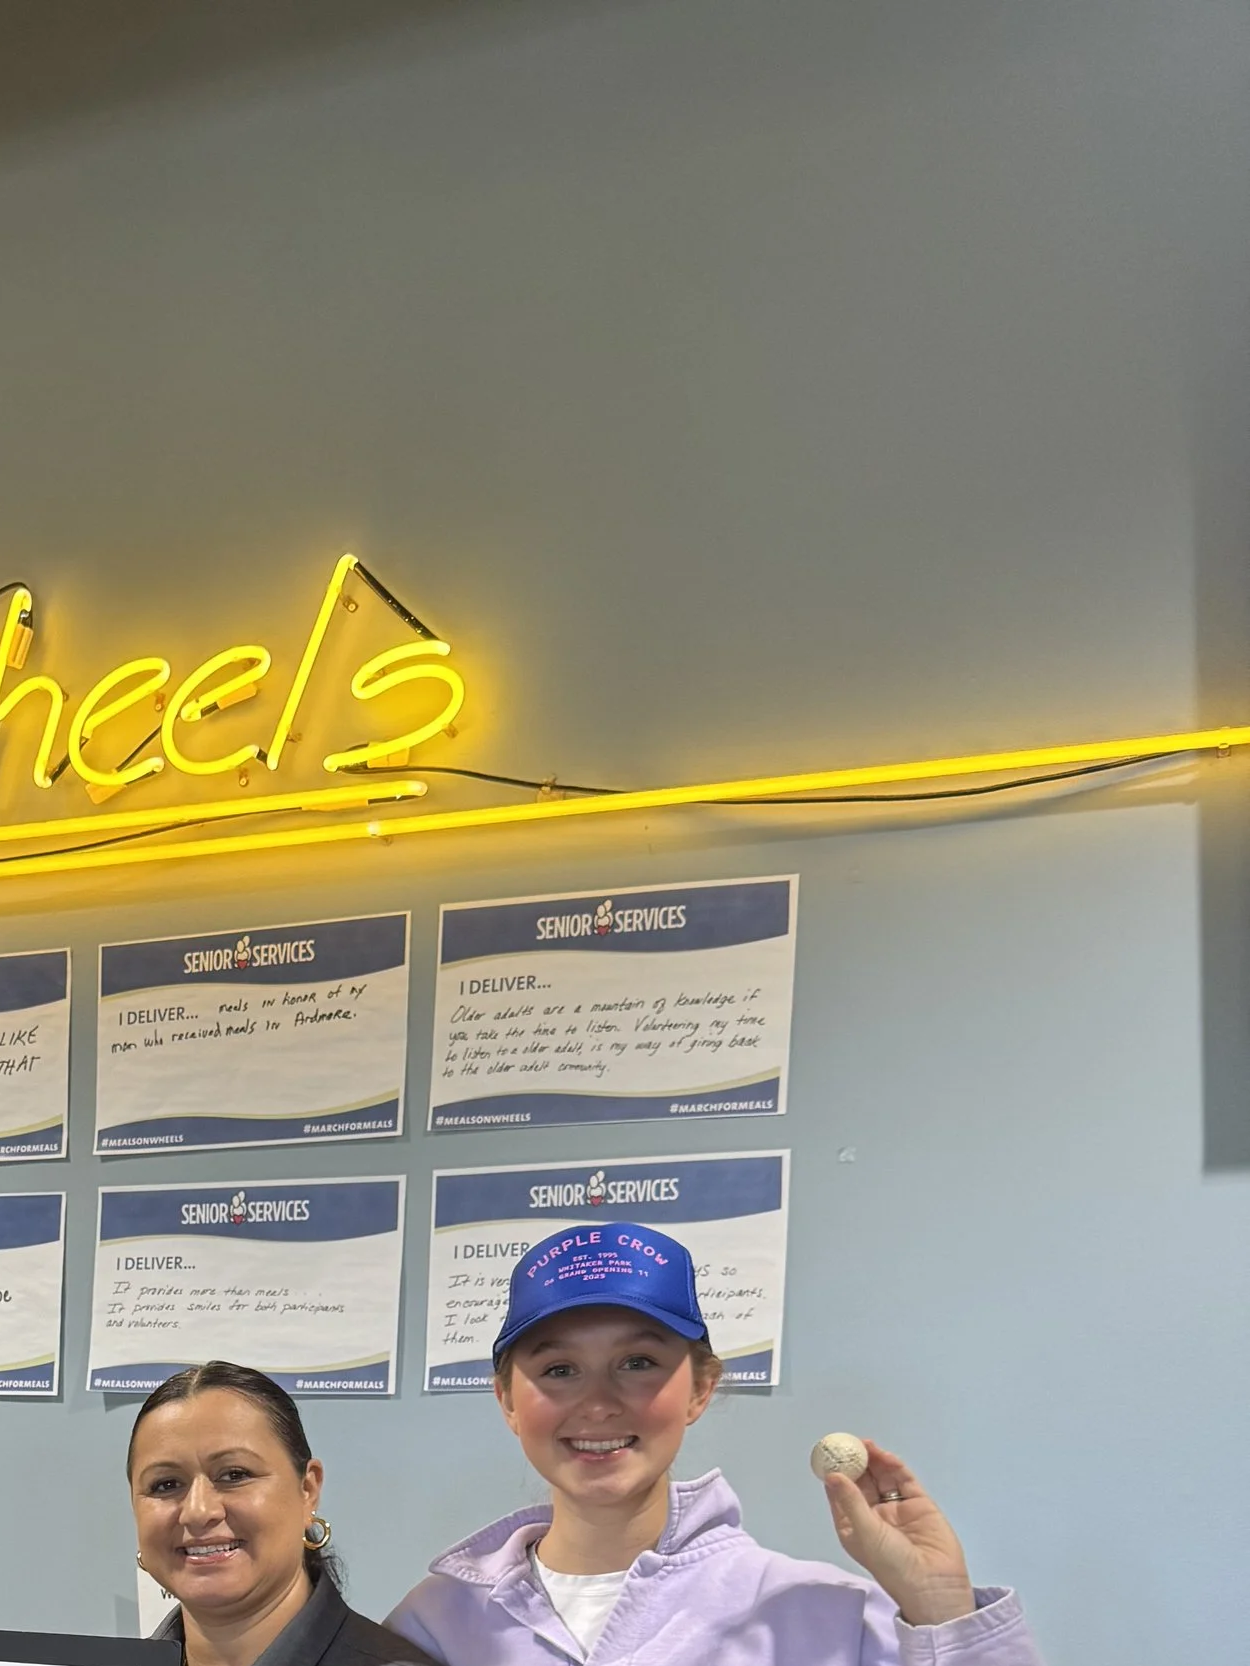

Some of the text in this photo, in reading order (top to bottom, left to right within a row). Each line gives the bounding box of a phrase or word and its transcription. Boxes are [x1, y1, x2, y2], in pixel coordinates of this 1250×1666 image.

[536, 905, 686, 940] SENIOR SERVICES
[183, 940, 314, 974] SENIOR SERVICES
[460, 975, 551, 995] I DELIVER...
[119, 1007, 198, 1025] I DELIVER...
[670, 1100, 773, 1113] #MARCHFORMEALS
[303, 1119, 393, 1134] #MARCHFORMEALS
[436, 1112, 531, 1126] #MEALSONWHEELS
[102, 1134, 184, 1147] #MEALSONWHEELS
[529, 1178, 679, 1208] SENIOR SERVICES
[181, 1200, 309, 1224] SENIOR SERVICES
[527, 1232, 669, 1278] PURPLE CROW
[116, 1256, 195, 1271] I DELIVER...
[559, 1270, 586, 1280] GRAND
[138, 1286, 183, 1299] provides
[190, 1288, 216, 1297] more
[223, 1286, 251, 1296] than
[296, 1379, 384, 1390] #MARCHFORMEALS
